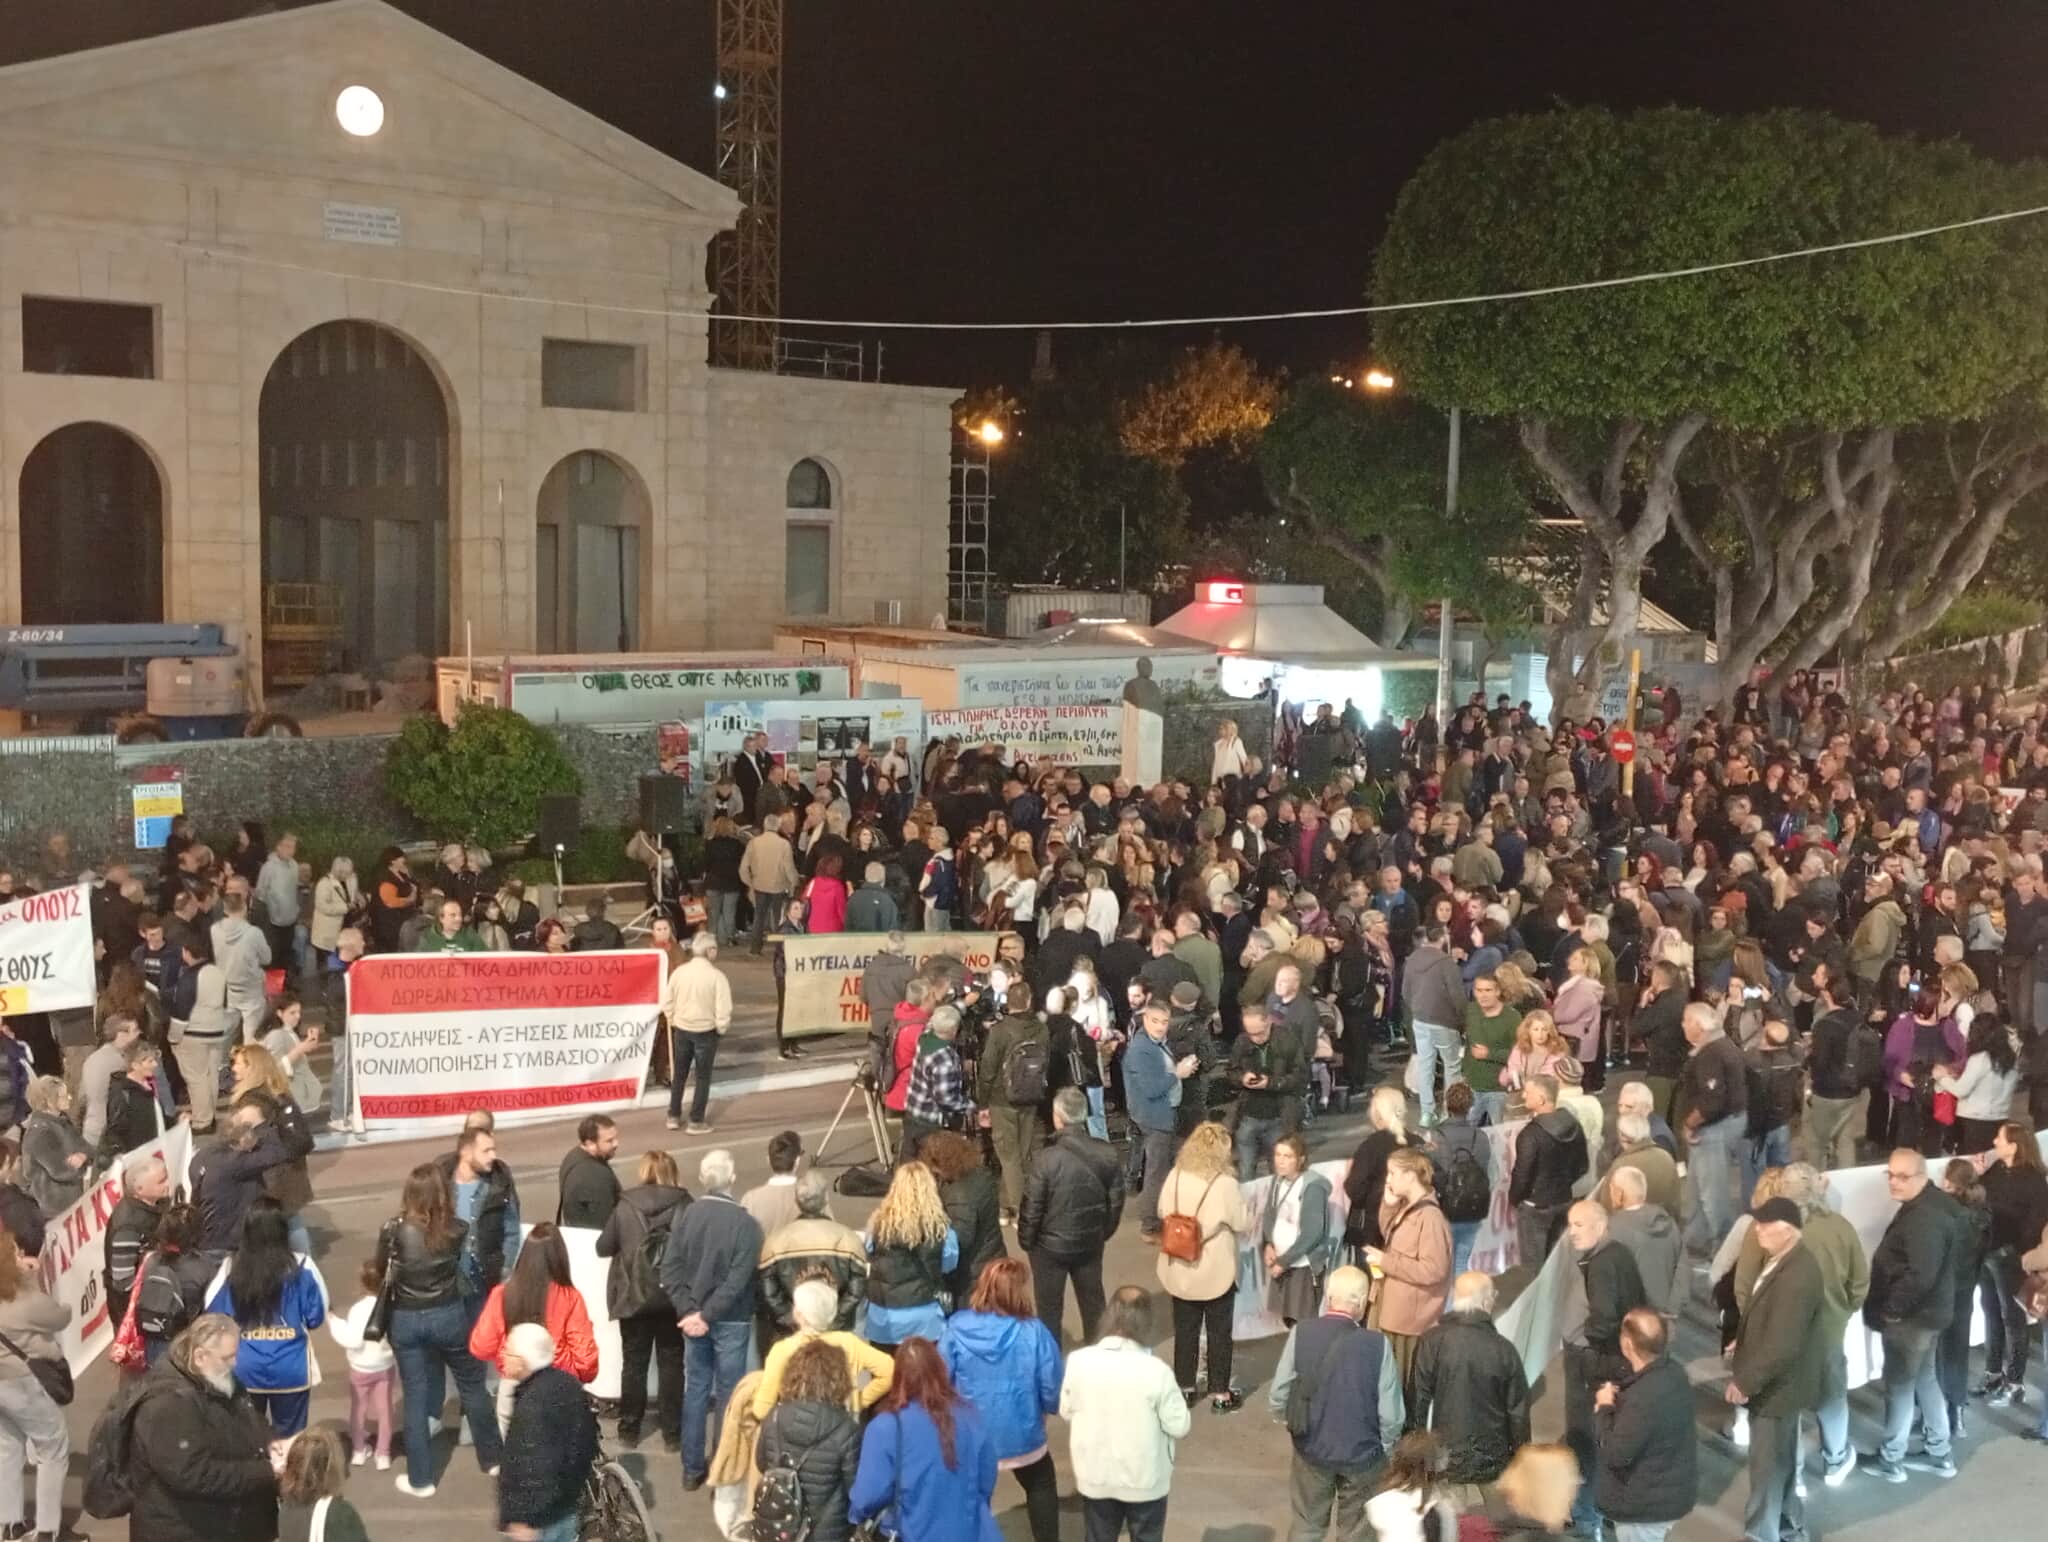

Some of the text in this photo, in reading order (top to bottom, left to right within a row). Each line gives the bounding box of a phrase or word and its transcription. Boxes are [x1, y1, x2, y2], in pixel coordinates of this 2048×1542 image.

[505, 960, 593, 977] ΔΗΜΟΣΙΟ
[597, 958, 625, 976] ΚΑΙ
[810, 954, 849, 971] ΥΓΕΙΑ
[391, 983, 614, 1005] ΔΩΡΕΑΝ ΣΥΣΤΗΜΑ ΥΓΕΙΑΣ
[478, 1024, 568, 1044] ΑΥΞΗΣΕΙΣ
[572, 1021, 649, 1039] ΜΙΣΘΩΝ
[502, 1041, 647, 1069] ΣΥΜΒΑΣΙΟΥΧΩΝ
